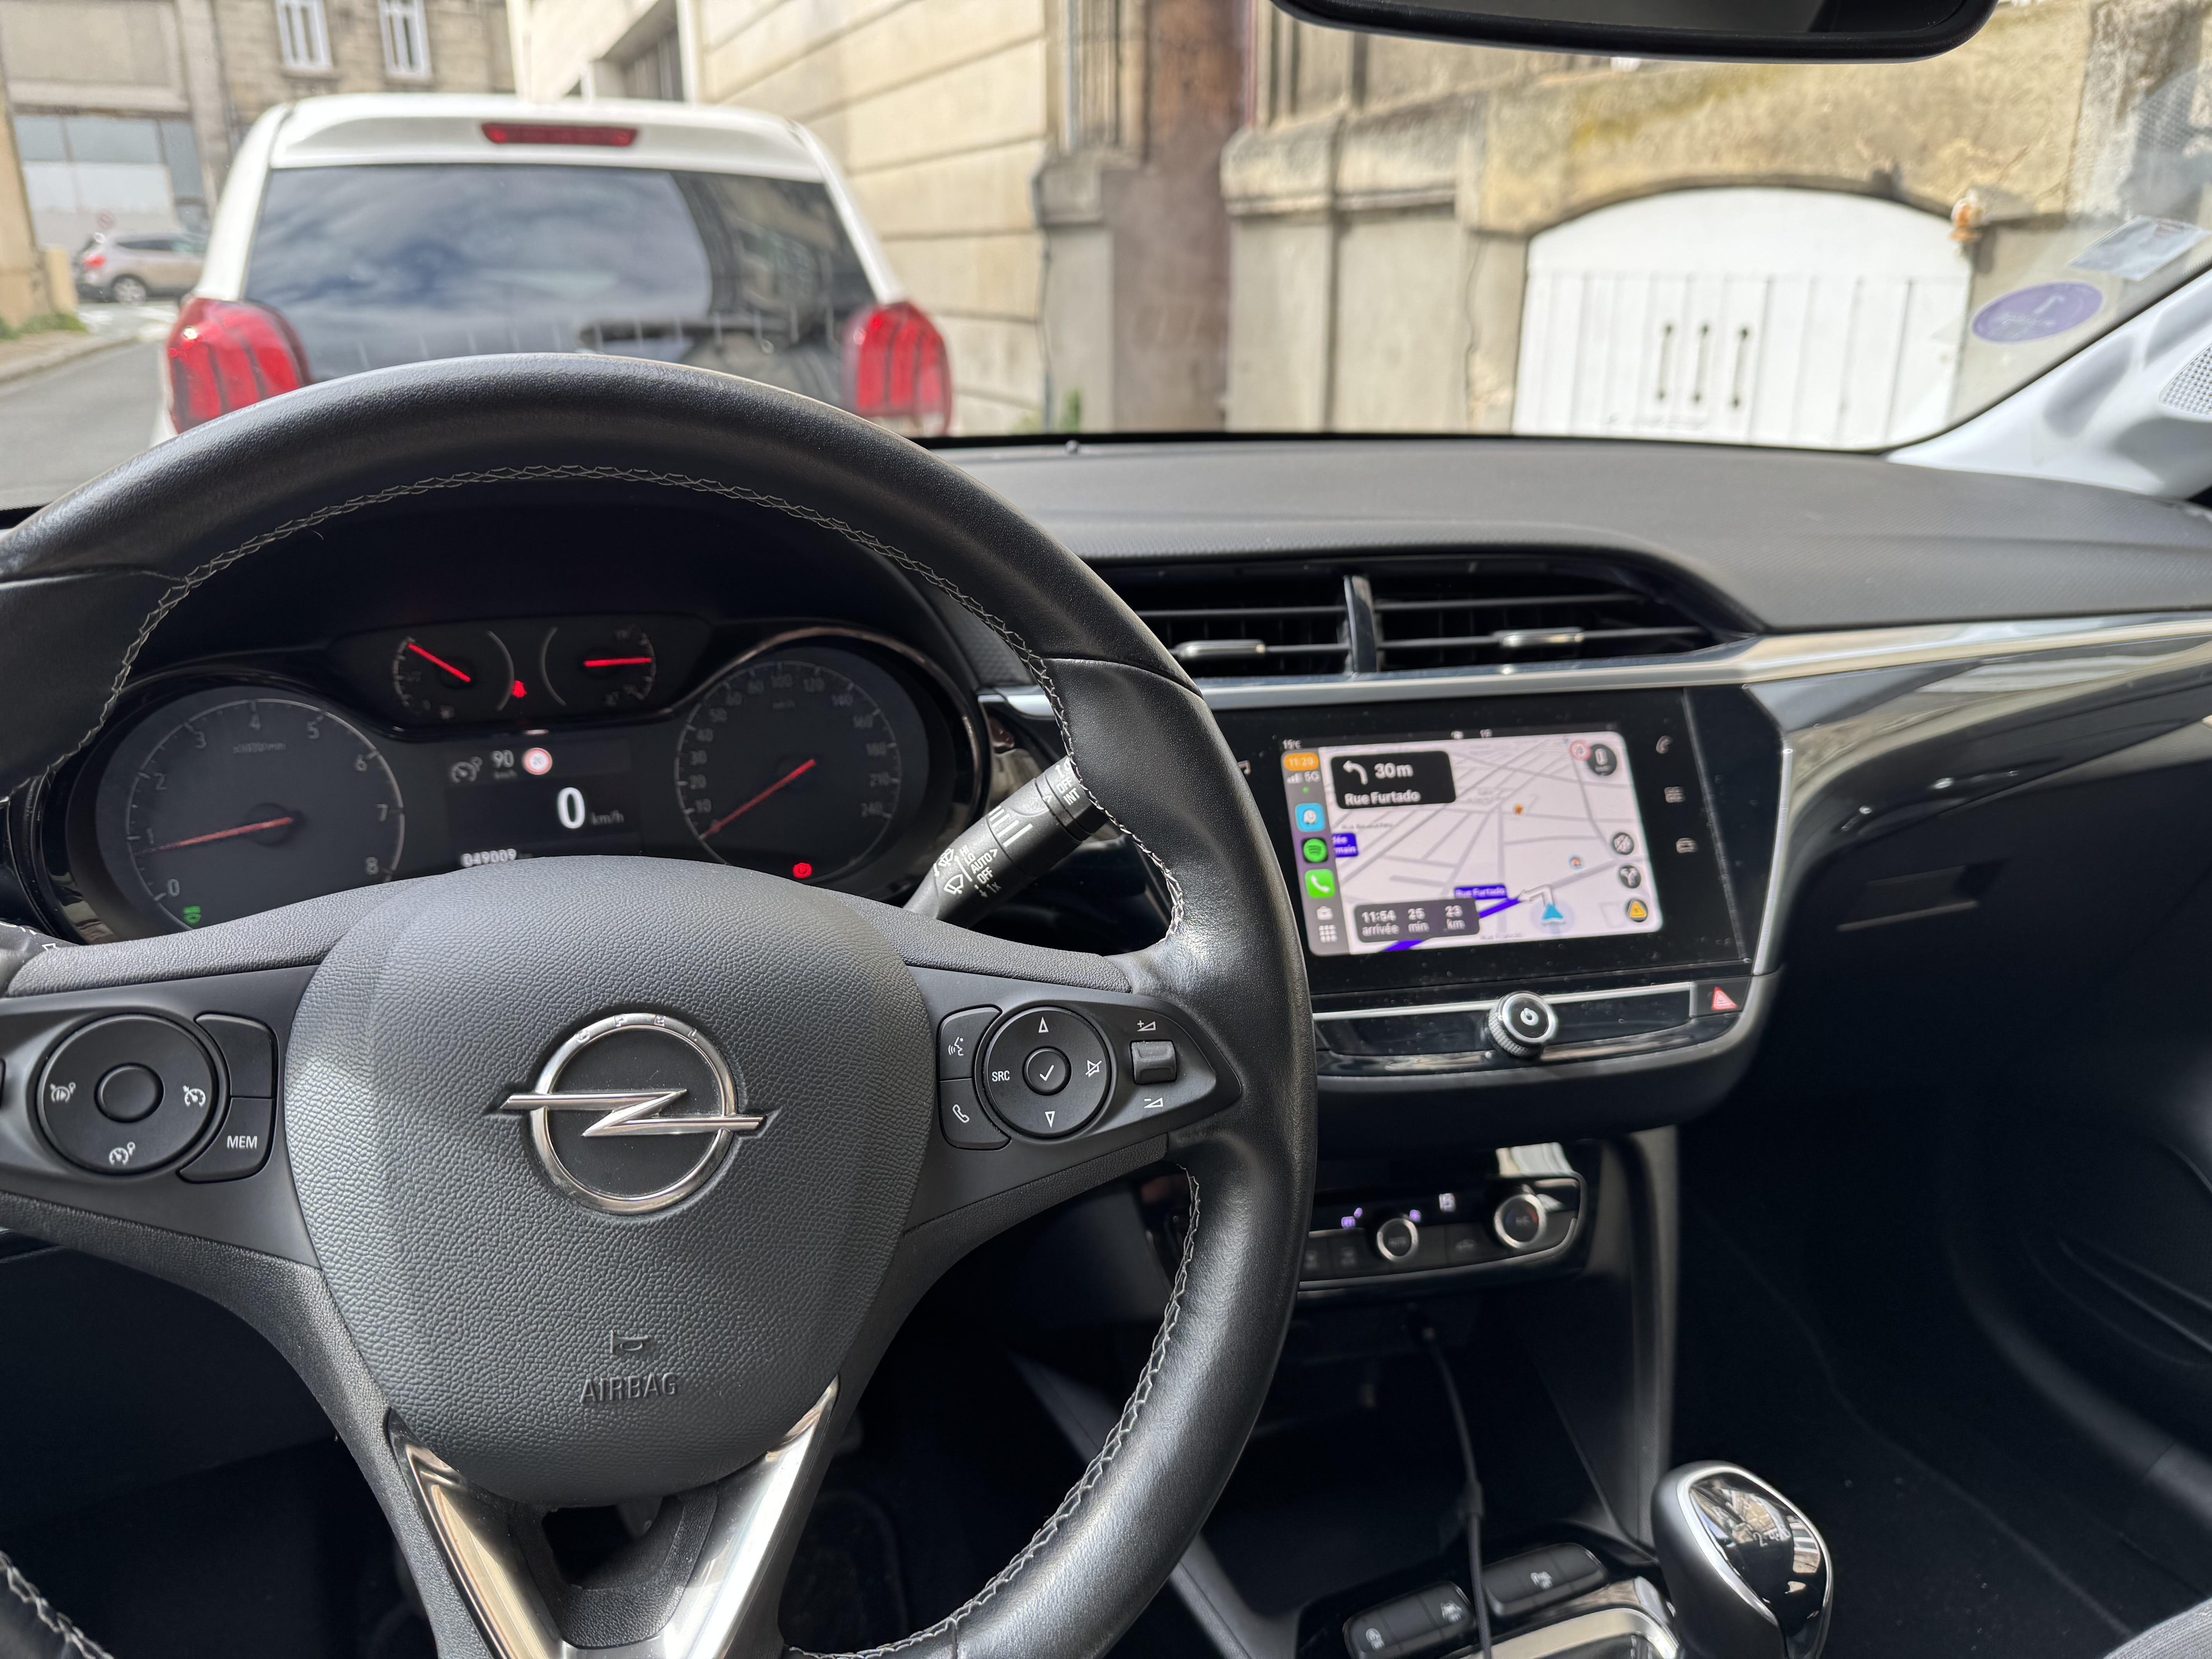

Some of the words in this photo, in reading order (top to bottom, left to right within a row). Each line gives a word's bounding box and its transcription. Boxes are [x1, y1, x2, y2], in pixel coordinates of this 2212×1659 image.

[804, 677, 824, 692] 120
[250, 714, 261, 730] 4
[308, 723, 319, 739] 5
[196, 732, 207, 749] 3
[355, 756, 367, 771] 6
[491, 749, 514, 768] 90
[156, 775, 167, 790] 2
[1056, 776, 1072, 794] OFF
[1304, 771, 1320, 782] 5G
[1063, 787, 1080, 805] INT
[1345, 793, 1370, 806] Rue
[1370, 789, 1421, 804] Furtado
[376, 804, 388, 821] 7
[557, 787, 585, 829] 0
[590, 809, 624, 826] km/h
[148, 828, 156, 844] 1
[460, 848, 517, 867] 049009
[959, 845, 969, 857] HI
[964, 853, 976, 866] LO
[366, 856, 378, 874] 8
[971, 852, 993, 874] AUTO
[977, 867, 993, 884] OFF
[168, 879, 180, 896] 0
[986, 882, 1001, 893] 1x
[1362, 910, 1396, 923] 11:54
[1408, 908, 1425, 920] 25
[1445, 905, 1463, 917] 23
[1362, 923, 1400, 936] arrivée
[1408, 921, 1430, 933] min
[1447, 918, 1466, 930] km
[992, 1070, 1010, 1082] SRC
[227, 1135, 258, 1149] MEM
[581, 1372, 678, 1403] AIRBAG
[1753, 1532, 1768, 1547] 2
